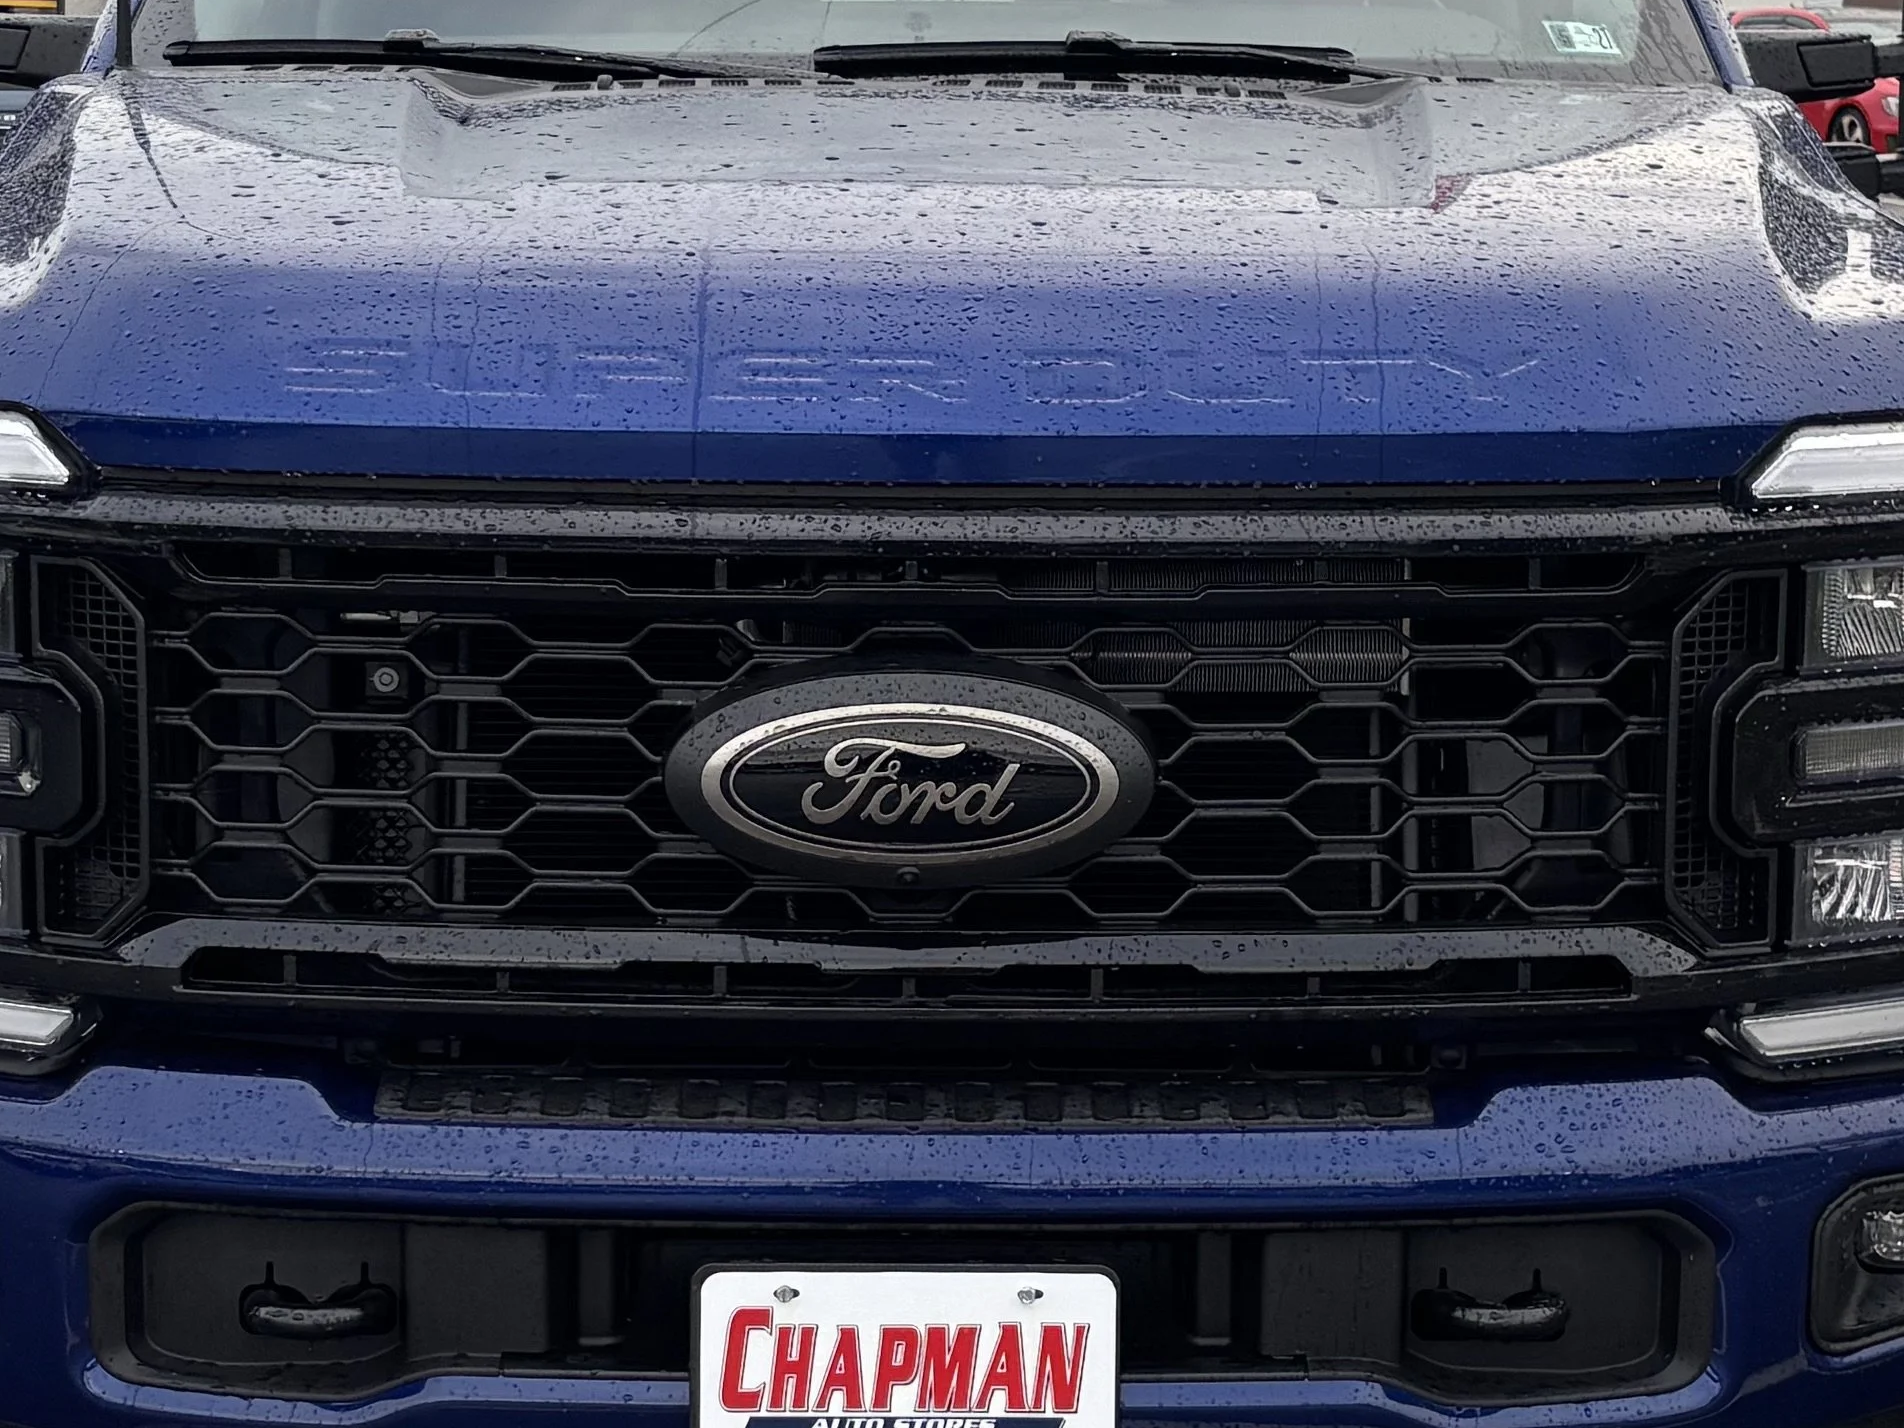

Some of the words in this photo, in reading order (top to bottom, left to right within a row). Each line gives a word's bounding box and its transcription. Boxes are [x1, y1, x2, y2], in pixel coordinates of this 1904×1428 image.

[1022, 349, 1538, 404] DUTY
[801, 737, 1021, 825] Ford
[718, 1305, 1091, 1413] CHAPMAN
